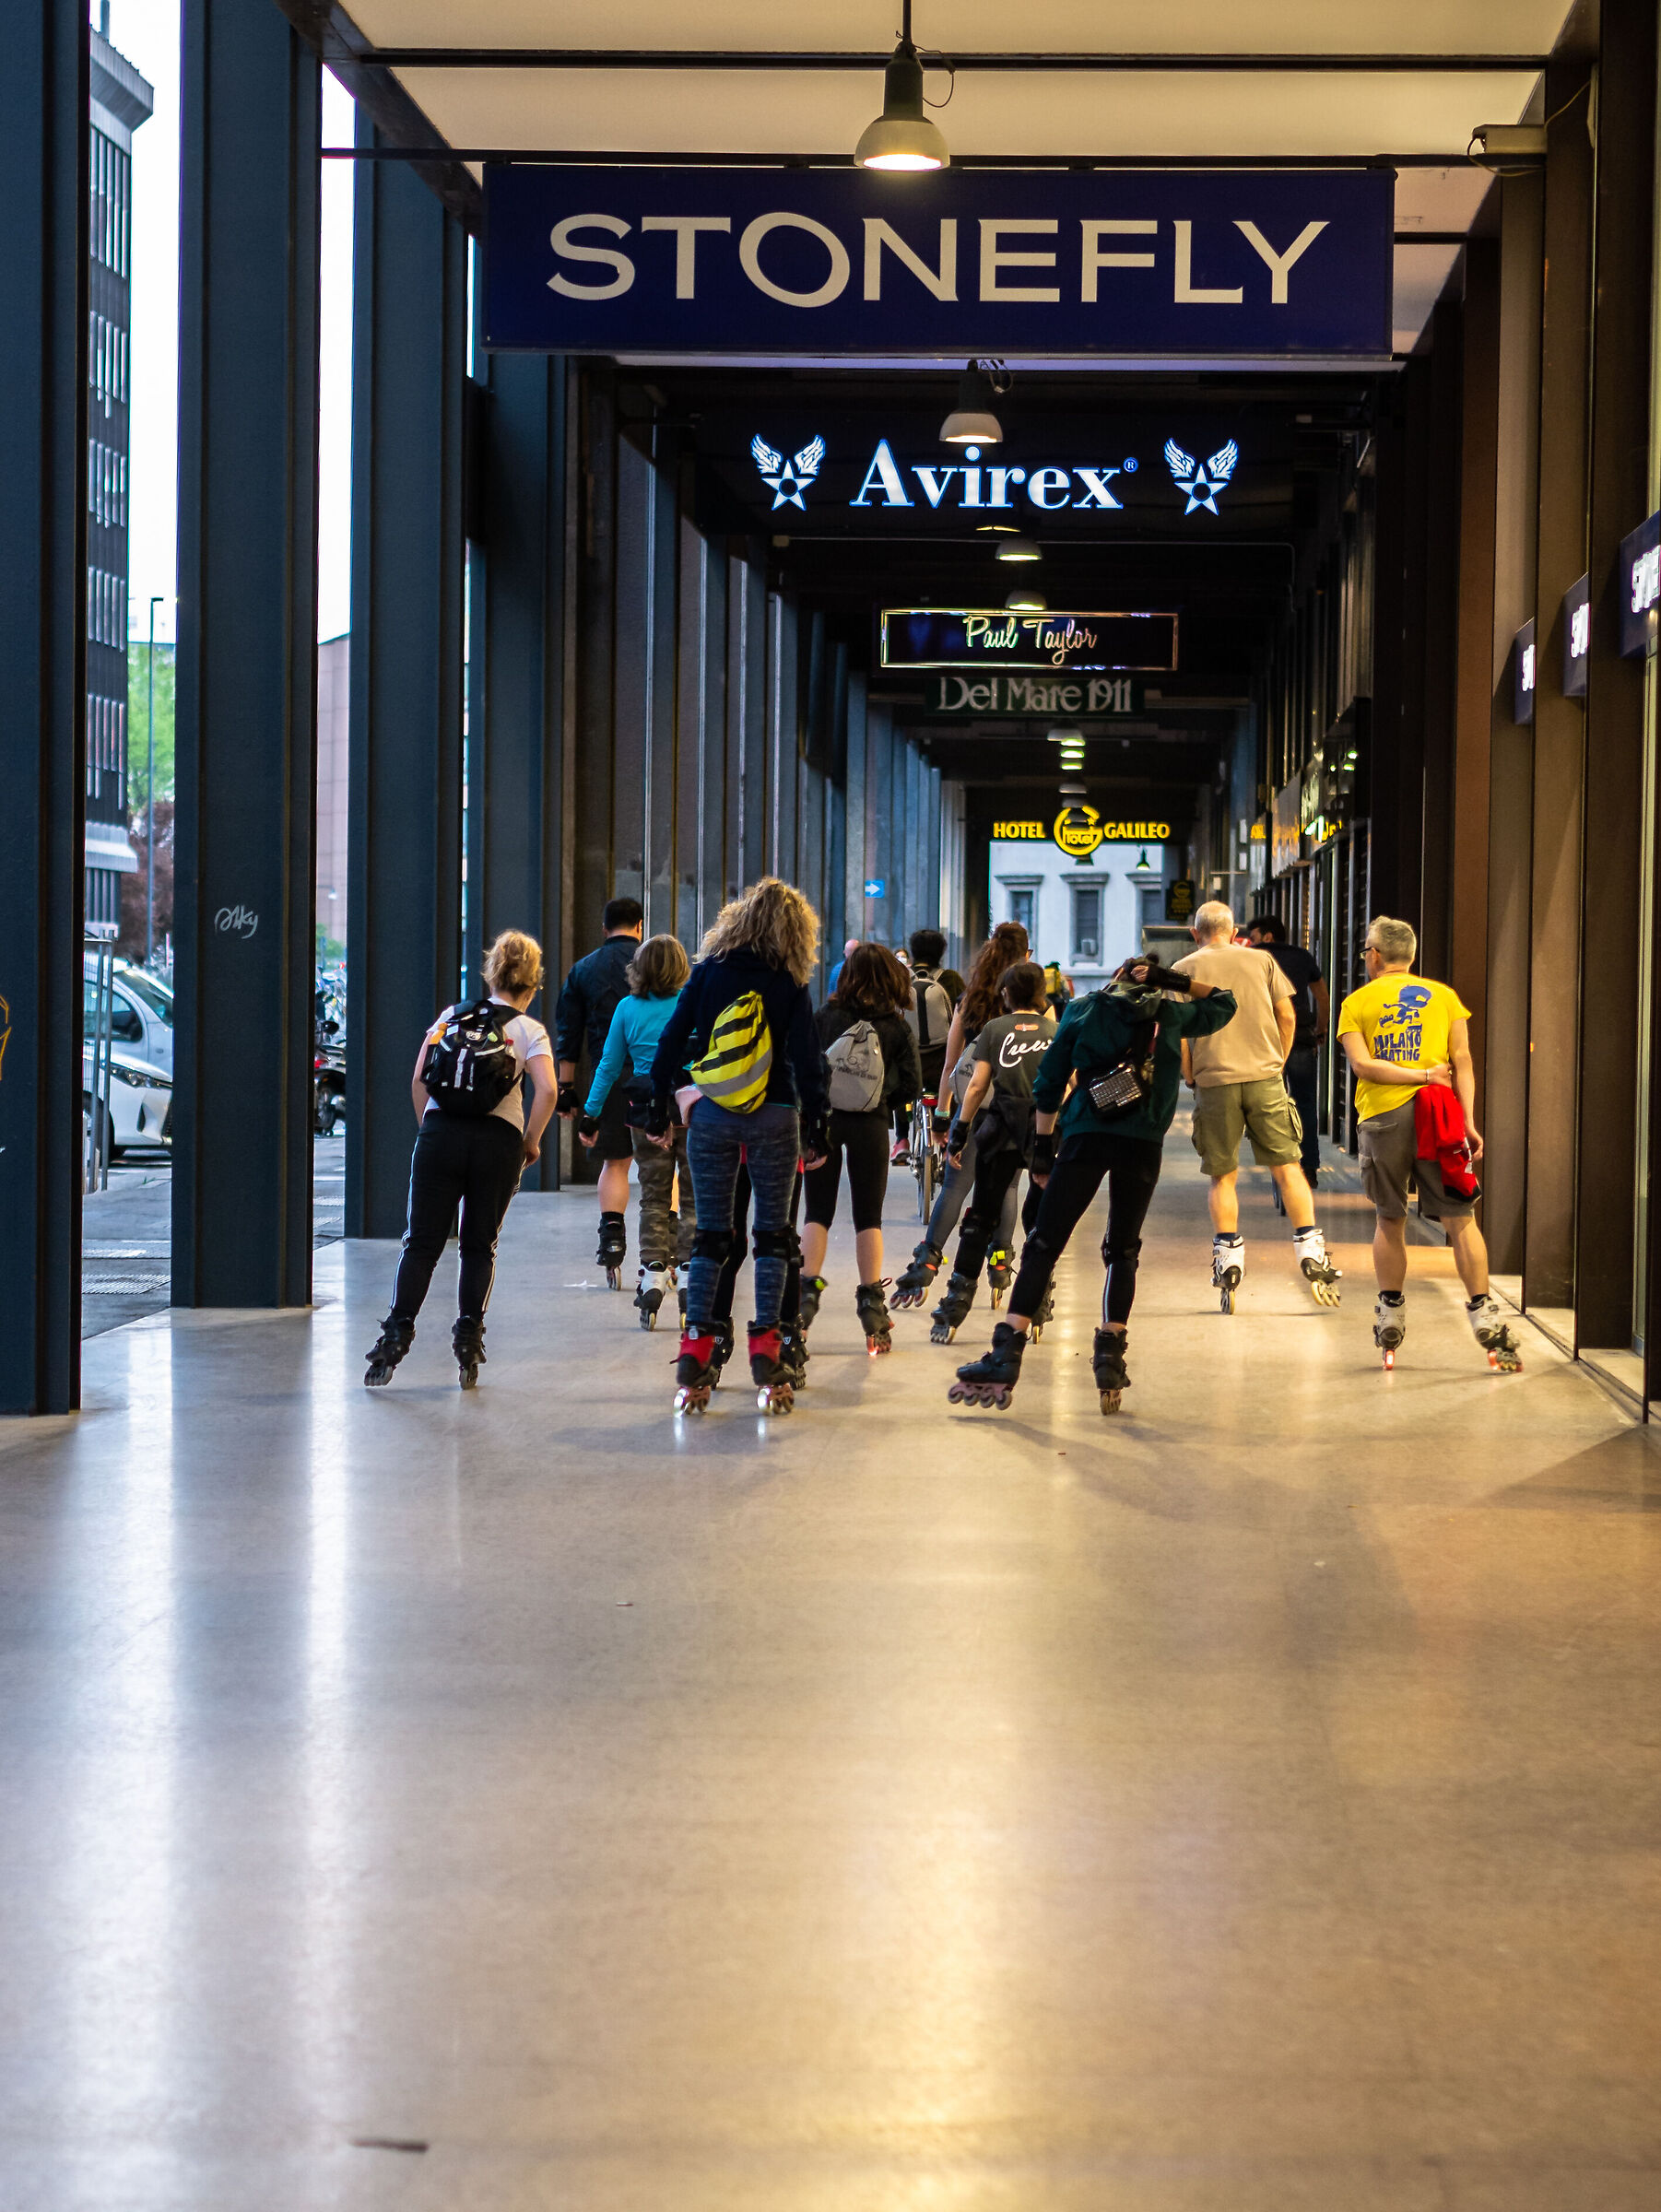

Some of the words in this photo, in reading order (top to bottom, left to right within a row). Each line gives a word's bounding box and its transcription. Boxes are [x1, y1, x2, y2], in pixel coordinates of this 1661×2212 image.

[547, 212, 1330, 308] STONEFLY
[962, 616, 1019, 649] Paul
[1021, 618, 1098, 665] Taylor
[937, 677, 998, 711] Del
[1007, 677, 1082, 712] Mare
[1086, 678, 1132, 712] 1911
[993, 821, 1046, 839] HOTEL
[1103, 821, 1171, 839] GALILEO
[999, 1032, 1053, 1068] Crew
[1373, 1030, 1421, 1051] MILANO
